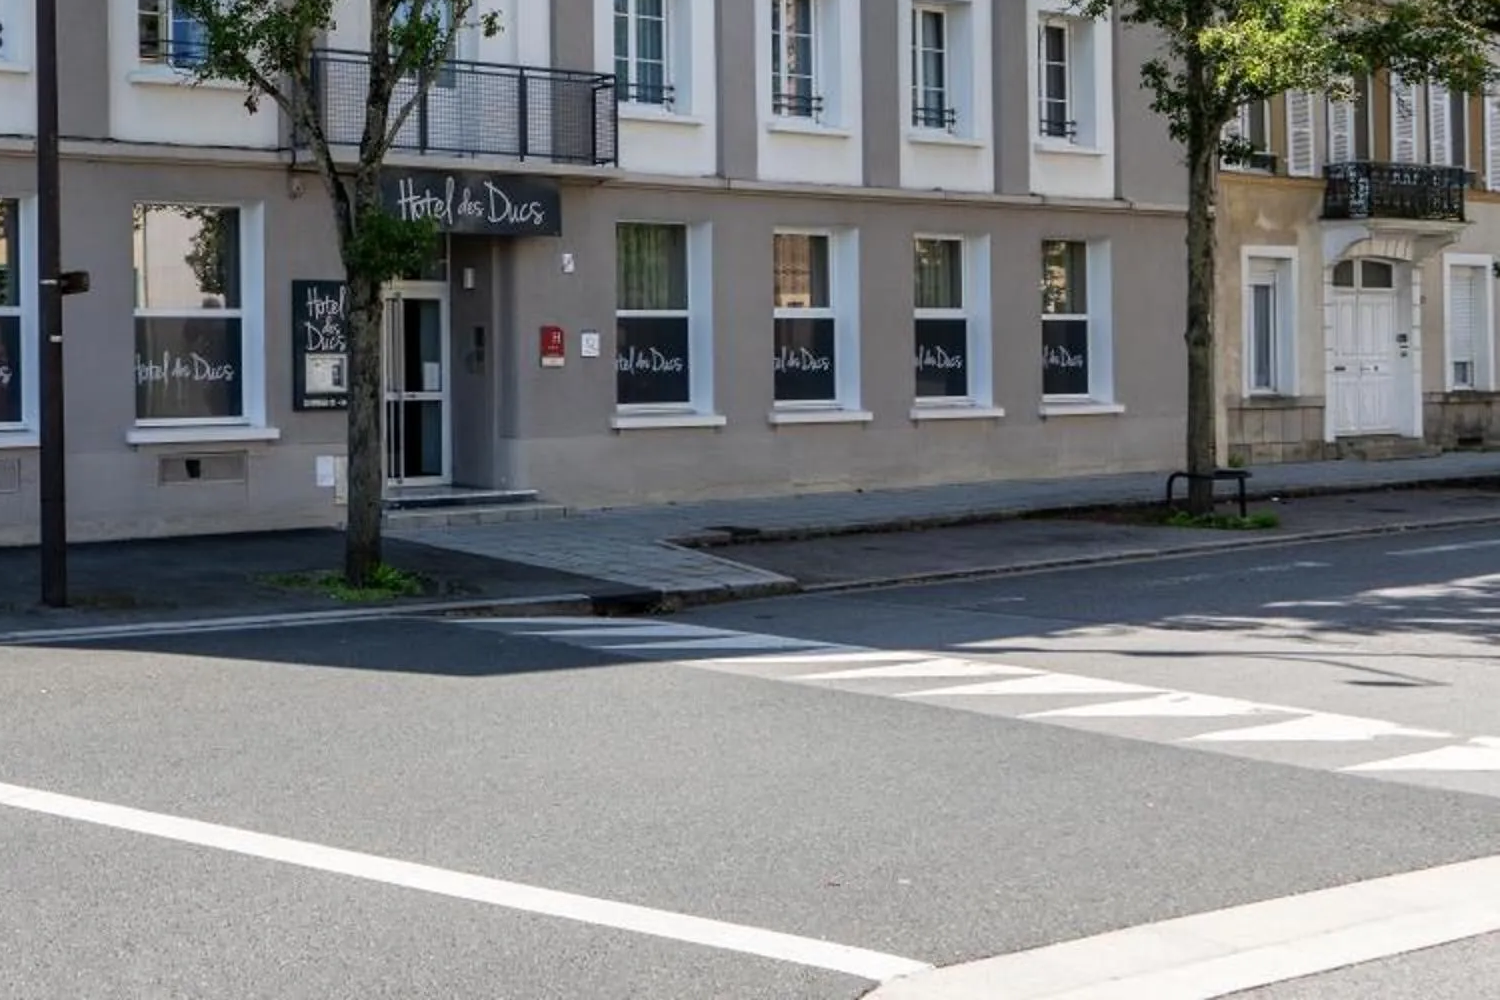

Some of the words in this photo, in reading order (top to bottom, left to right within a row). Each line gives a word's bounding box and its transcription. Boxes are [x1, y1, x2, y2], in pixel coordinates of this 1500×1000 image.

[397, 175, 455, 226] Hotel
[457, 186, 485, 217] des
[484, 179, 546, 226] Ducs
[305, 284, 347, 321] Hotel
[303, 321, 347, 352] Ducs
[189, 351, 235, 381] Ducs
[649, 347, 684, 372] Ducs
